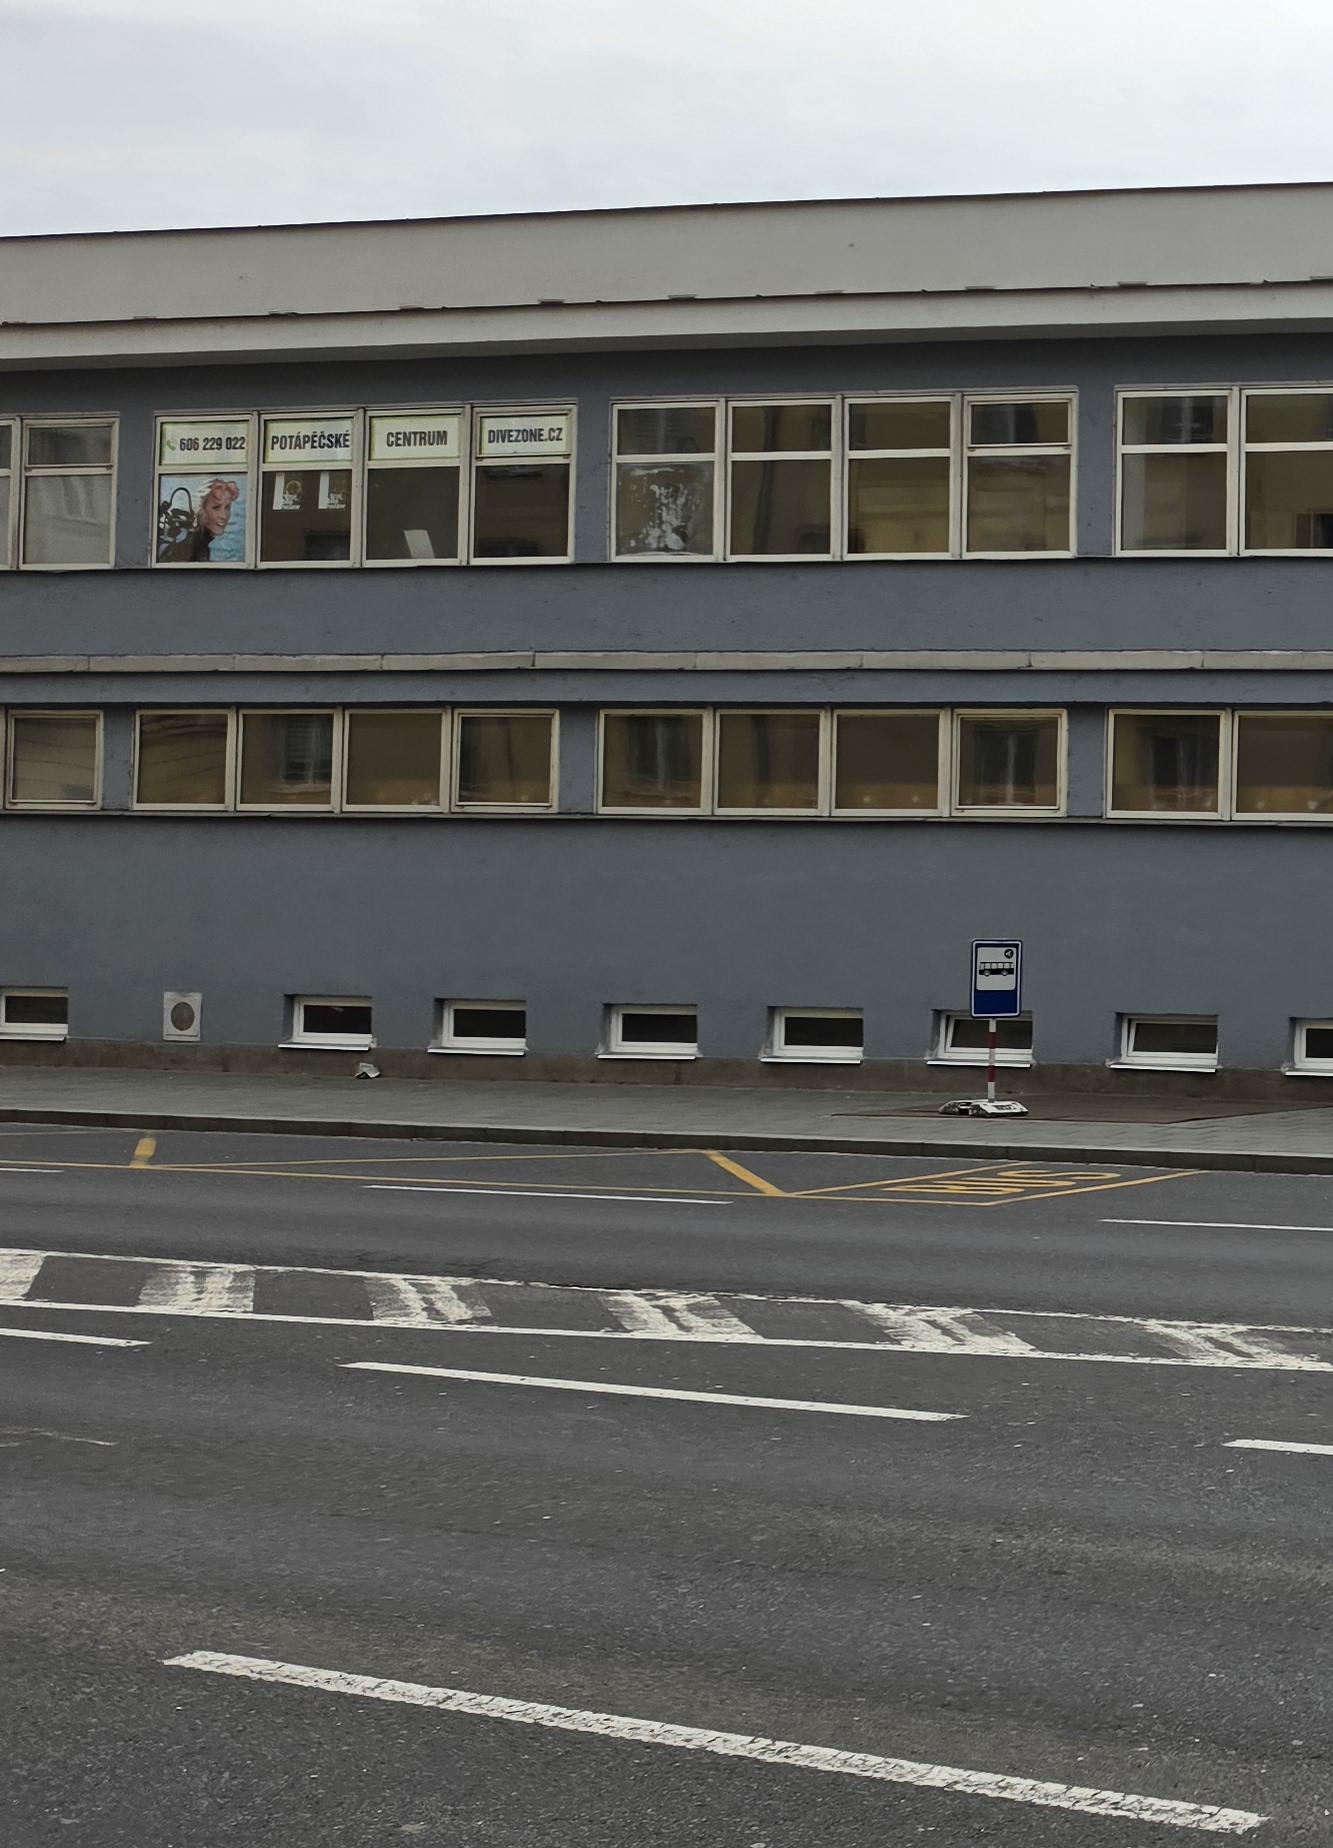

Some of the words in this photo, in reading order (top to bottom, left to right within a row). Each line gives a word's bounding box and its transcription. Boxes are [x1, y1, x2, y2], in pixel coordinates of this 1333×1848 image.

[180, 437, 200, 451] 606
[202, 436, 223, 450] 229
[225, 436, 246, 450] 022
[271, 429, 350, 450] POTÁPĚČSKÉ
[386, 430, 448, 447] CENTRUM
[487, 427, 563, 444] DIVEZONE.CZ
[880, 1169, 1121, 1196] BUS
